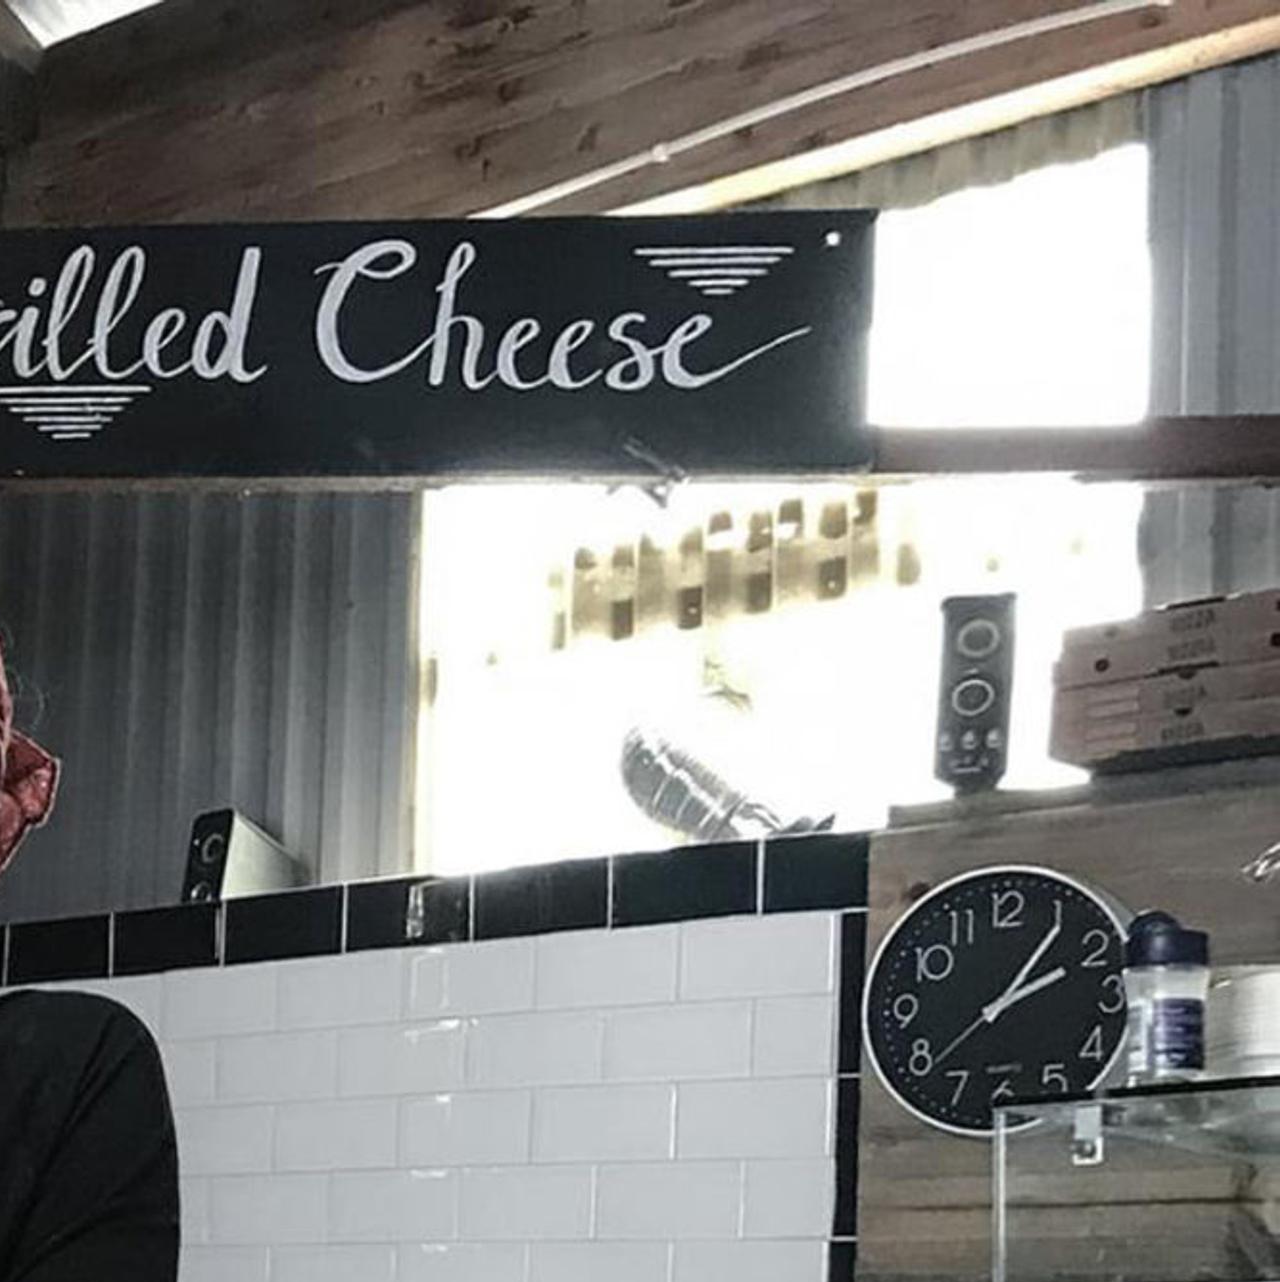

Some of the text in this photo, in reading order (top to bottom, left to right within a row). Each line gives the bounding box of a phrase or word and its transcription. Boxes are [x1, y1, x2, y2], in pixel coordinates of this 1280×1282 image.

[314, 240, 812, 389] Cheese
[949, 908, 975, 946] 11
[992, 890, 1025, 928] 12
[915, 944, 954, 982] 10
[1081, 929, 1109, 967] 2
[893, 993, 919, 1029] 9
[1098, 974, 1126, 1013] 3
[909, 1038, 933, 1076] 8
[1079, 1026, 1104, 1061] 4
[946, 1070, 969, 1106] 7
[1042, 1063, 1068, 1093] 5
